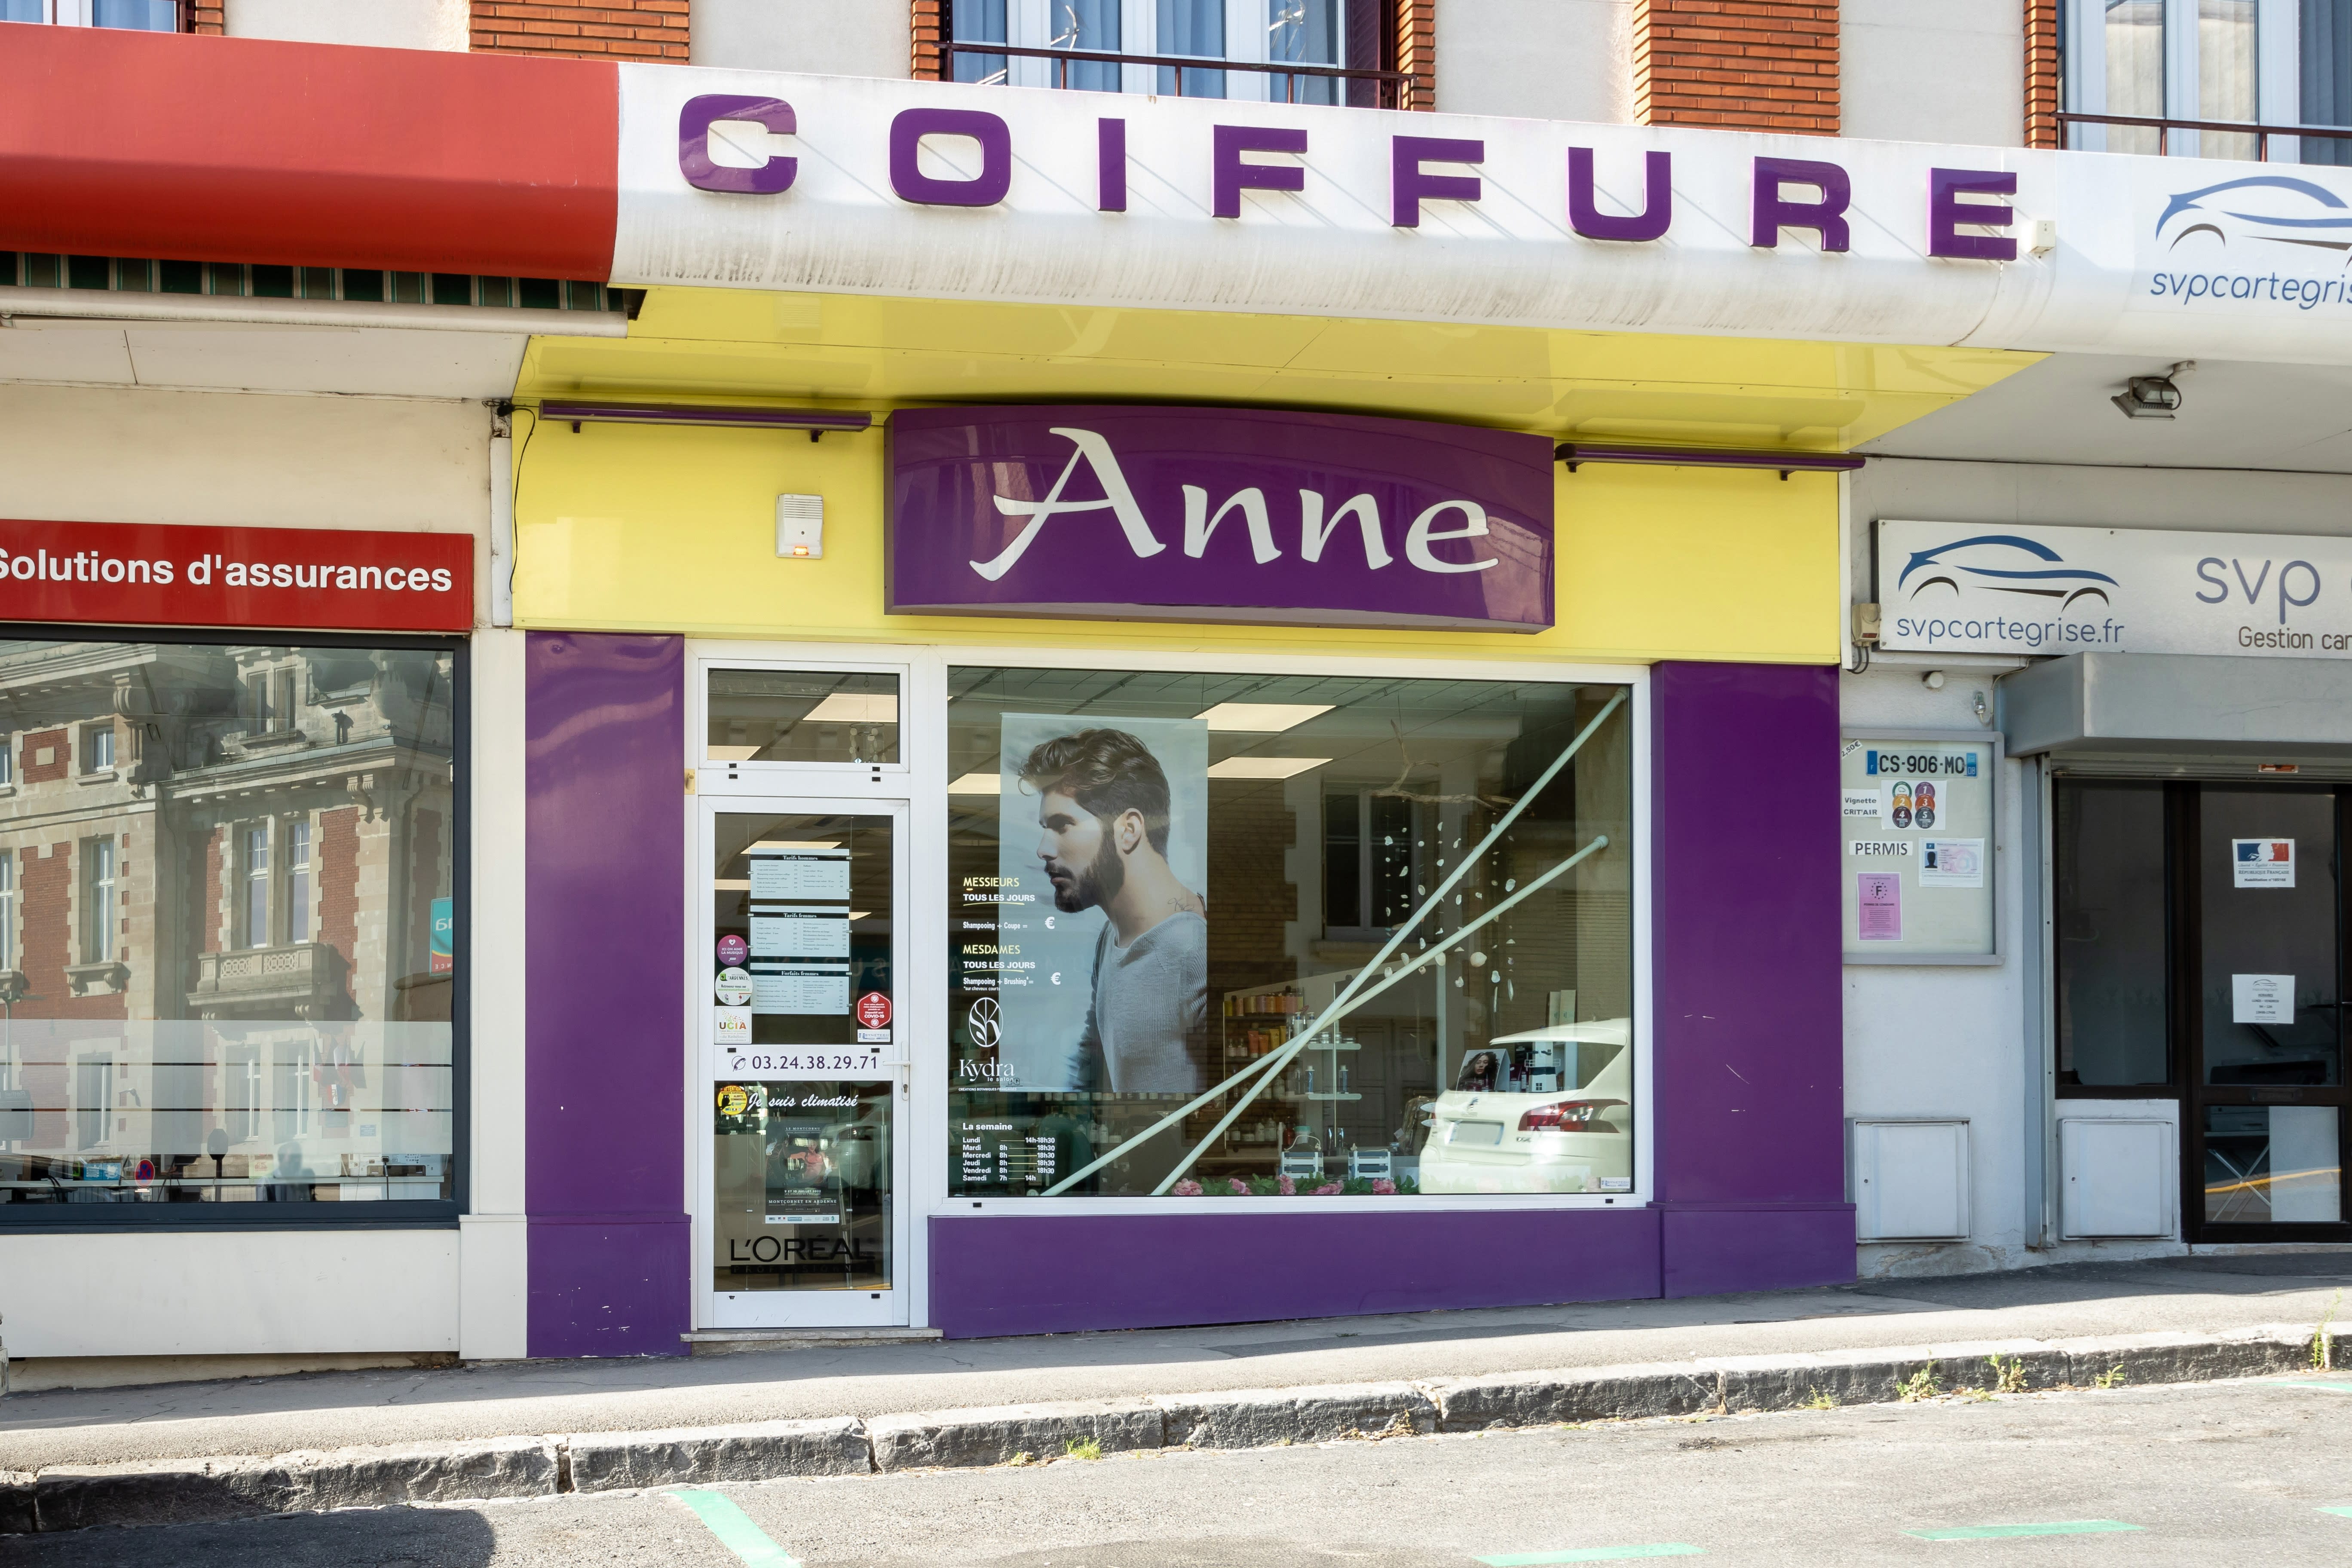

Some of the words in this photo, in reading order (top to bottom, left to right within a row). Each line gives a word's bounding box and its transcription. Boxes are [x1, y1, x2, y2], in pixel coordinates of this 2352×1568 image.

[679, 95, 2018, 261] COIFFURE
[969, 427, 1499, 582] Anne
[187, 554, 452, 592] d'assurances
[2196, 557, 2321, 625] svp
[1896, 616, 2125, 647] svpcartegrise.fr
[2239, 626, 2314, 650] Gestion
[1841, 741, 1861, 757] 2,50€
[1923, 786, 1927, 794] 1
[1922, 798, 1928, 806] 3
[1855, 842, 1908, 855] PERMIS
[963, 877, 1020, 887] MESSIEURS
[1876, 885, 1882, 896] F
[963, 894, 987, 902] TOUS
[963, 922, 995, 930] Shampooing
[1004, 922, 1021, 930] Coupe
[1044, 916, 1055, 930] €
[963, 944, 1020, 954] MESDAMES
[963, 977, 995, 986] Shampooing
[1050, 972, 1061, 985] €
[720, 1022, 747, 1030] UCIA
[753, 1056, 878, 1070] 03.24.38.29.71
[959, 1057, 1015, 1082] Kydra
[747, 1092, 763, 1111] Je
[768, 1096, 795, 1107] suis
[802, 1094, 859, 1108] climatisé
[730, 1235, 876, 1262] L'ORÉAL
